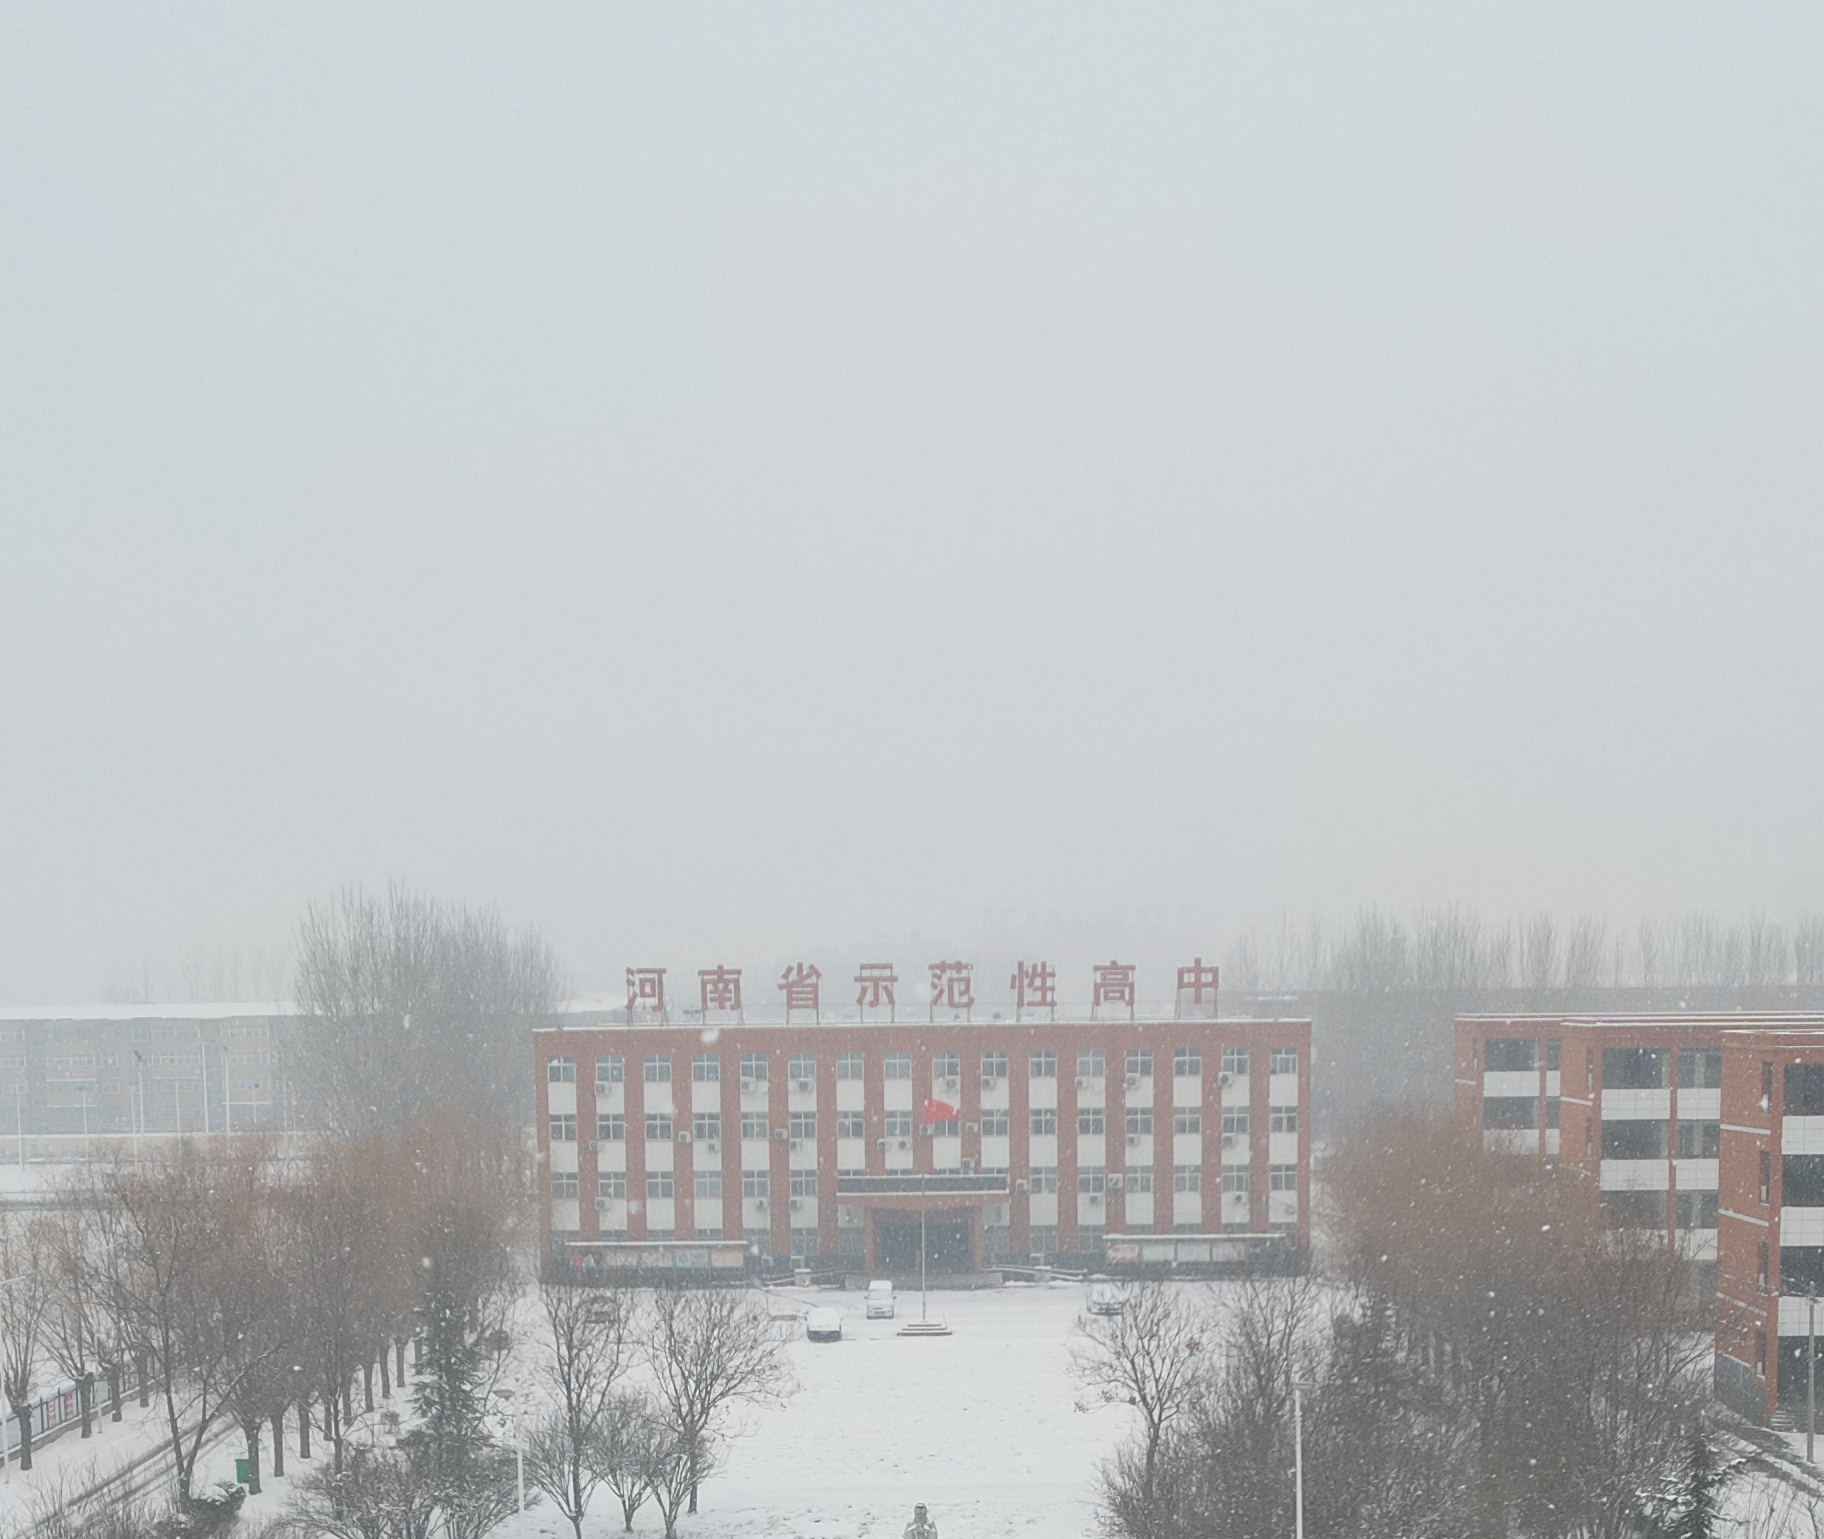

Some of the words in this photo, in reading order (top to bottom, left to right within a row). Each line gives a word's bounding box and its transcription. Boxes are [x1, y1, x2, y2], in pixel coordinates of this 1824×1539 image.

[625, 957, 1221, 1013] 河南省示范性高中
